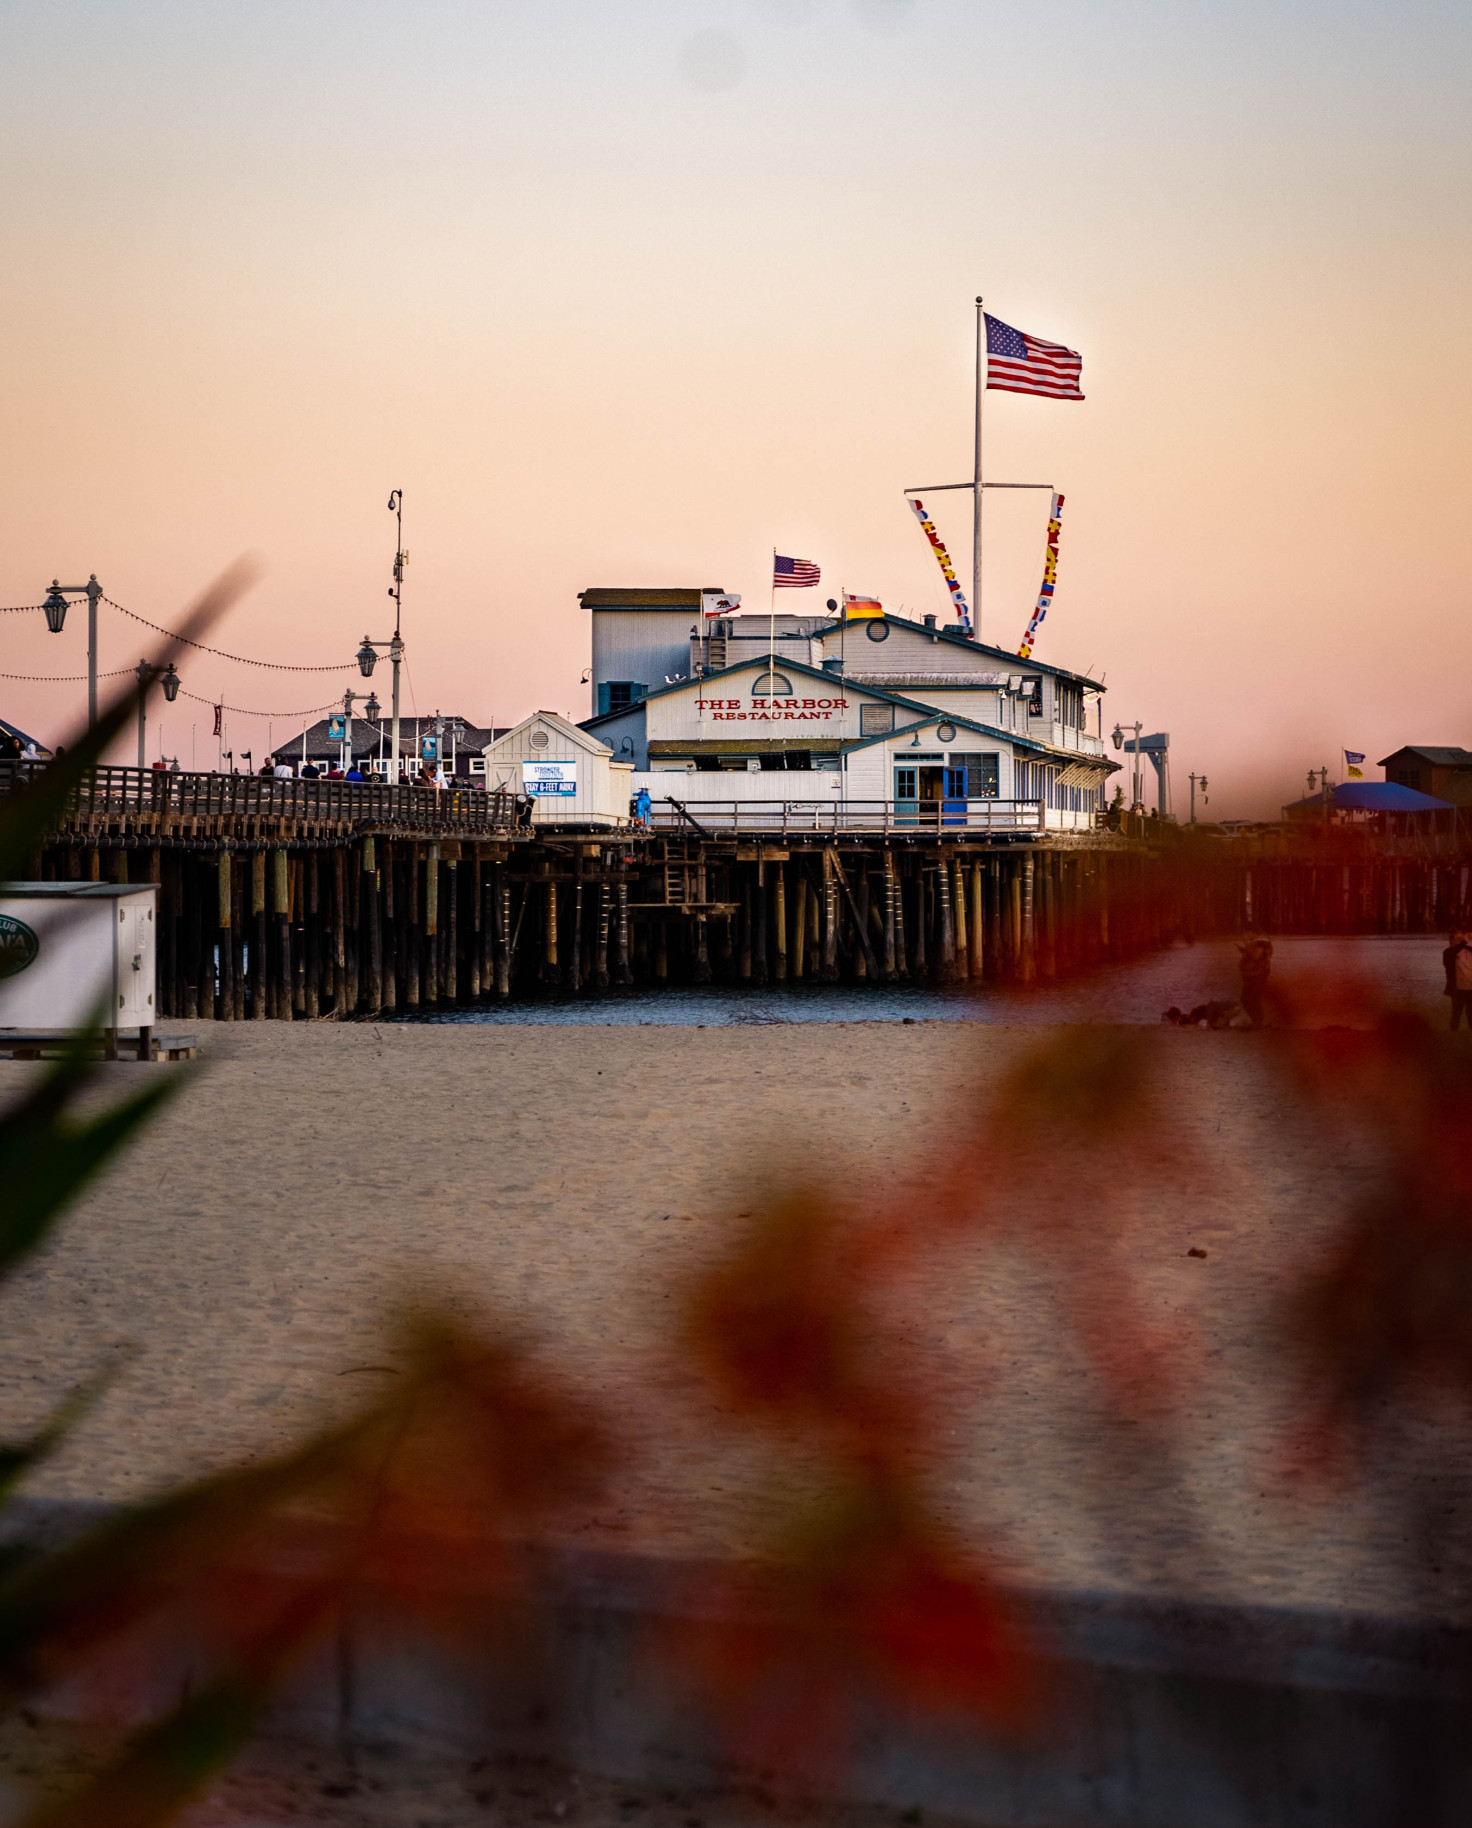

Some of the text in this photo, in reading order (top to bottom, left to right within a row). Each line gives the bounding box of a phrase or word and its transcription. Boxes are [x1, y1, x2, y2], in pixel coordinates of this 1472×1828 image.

[695, 699, 850, 709] THE HARBOR
[712, 712, 832, 720] RESTAURANT
[525, 783, 574, 791] STAY 6-FEET AWAY
